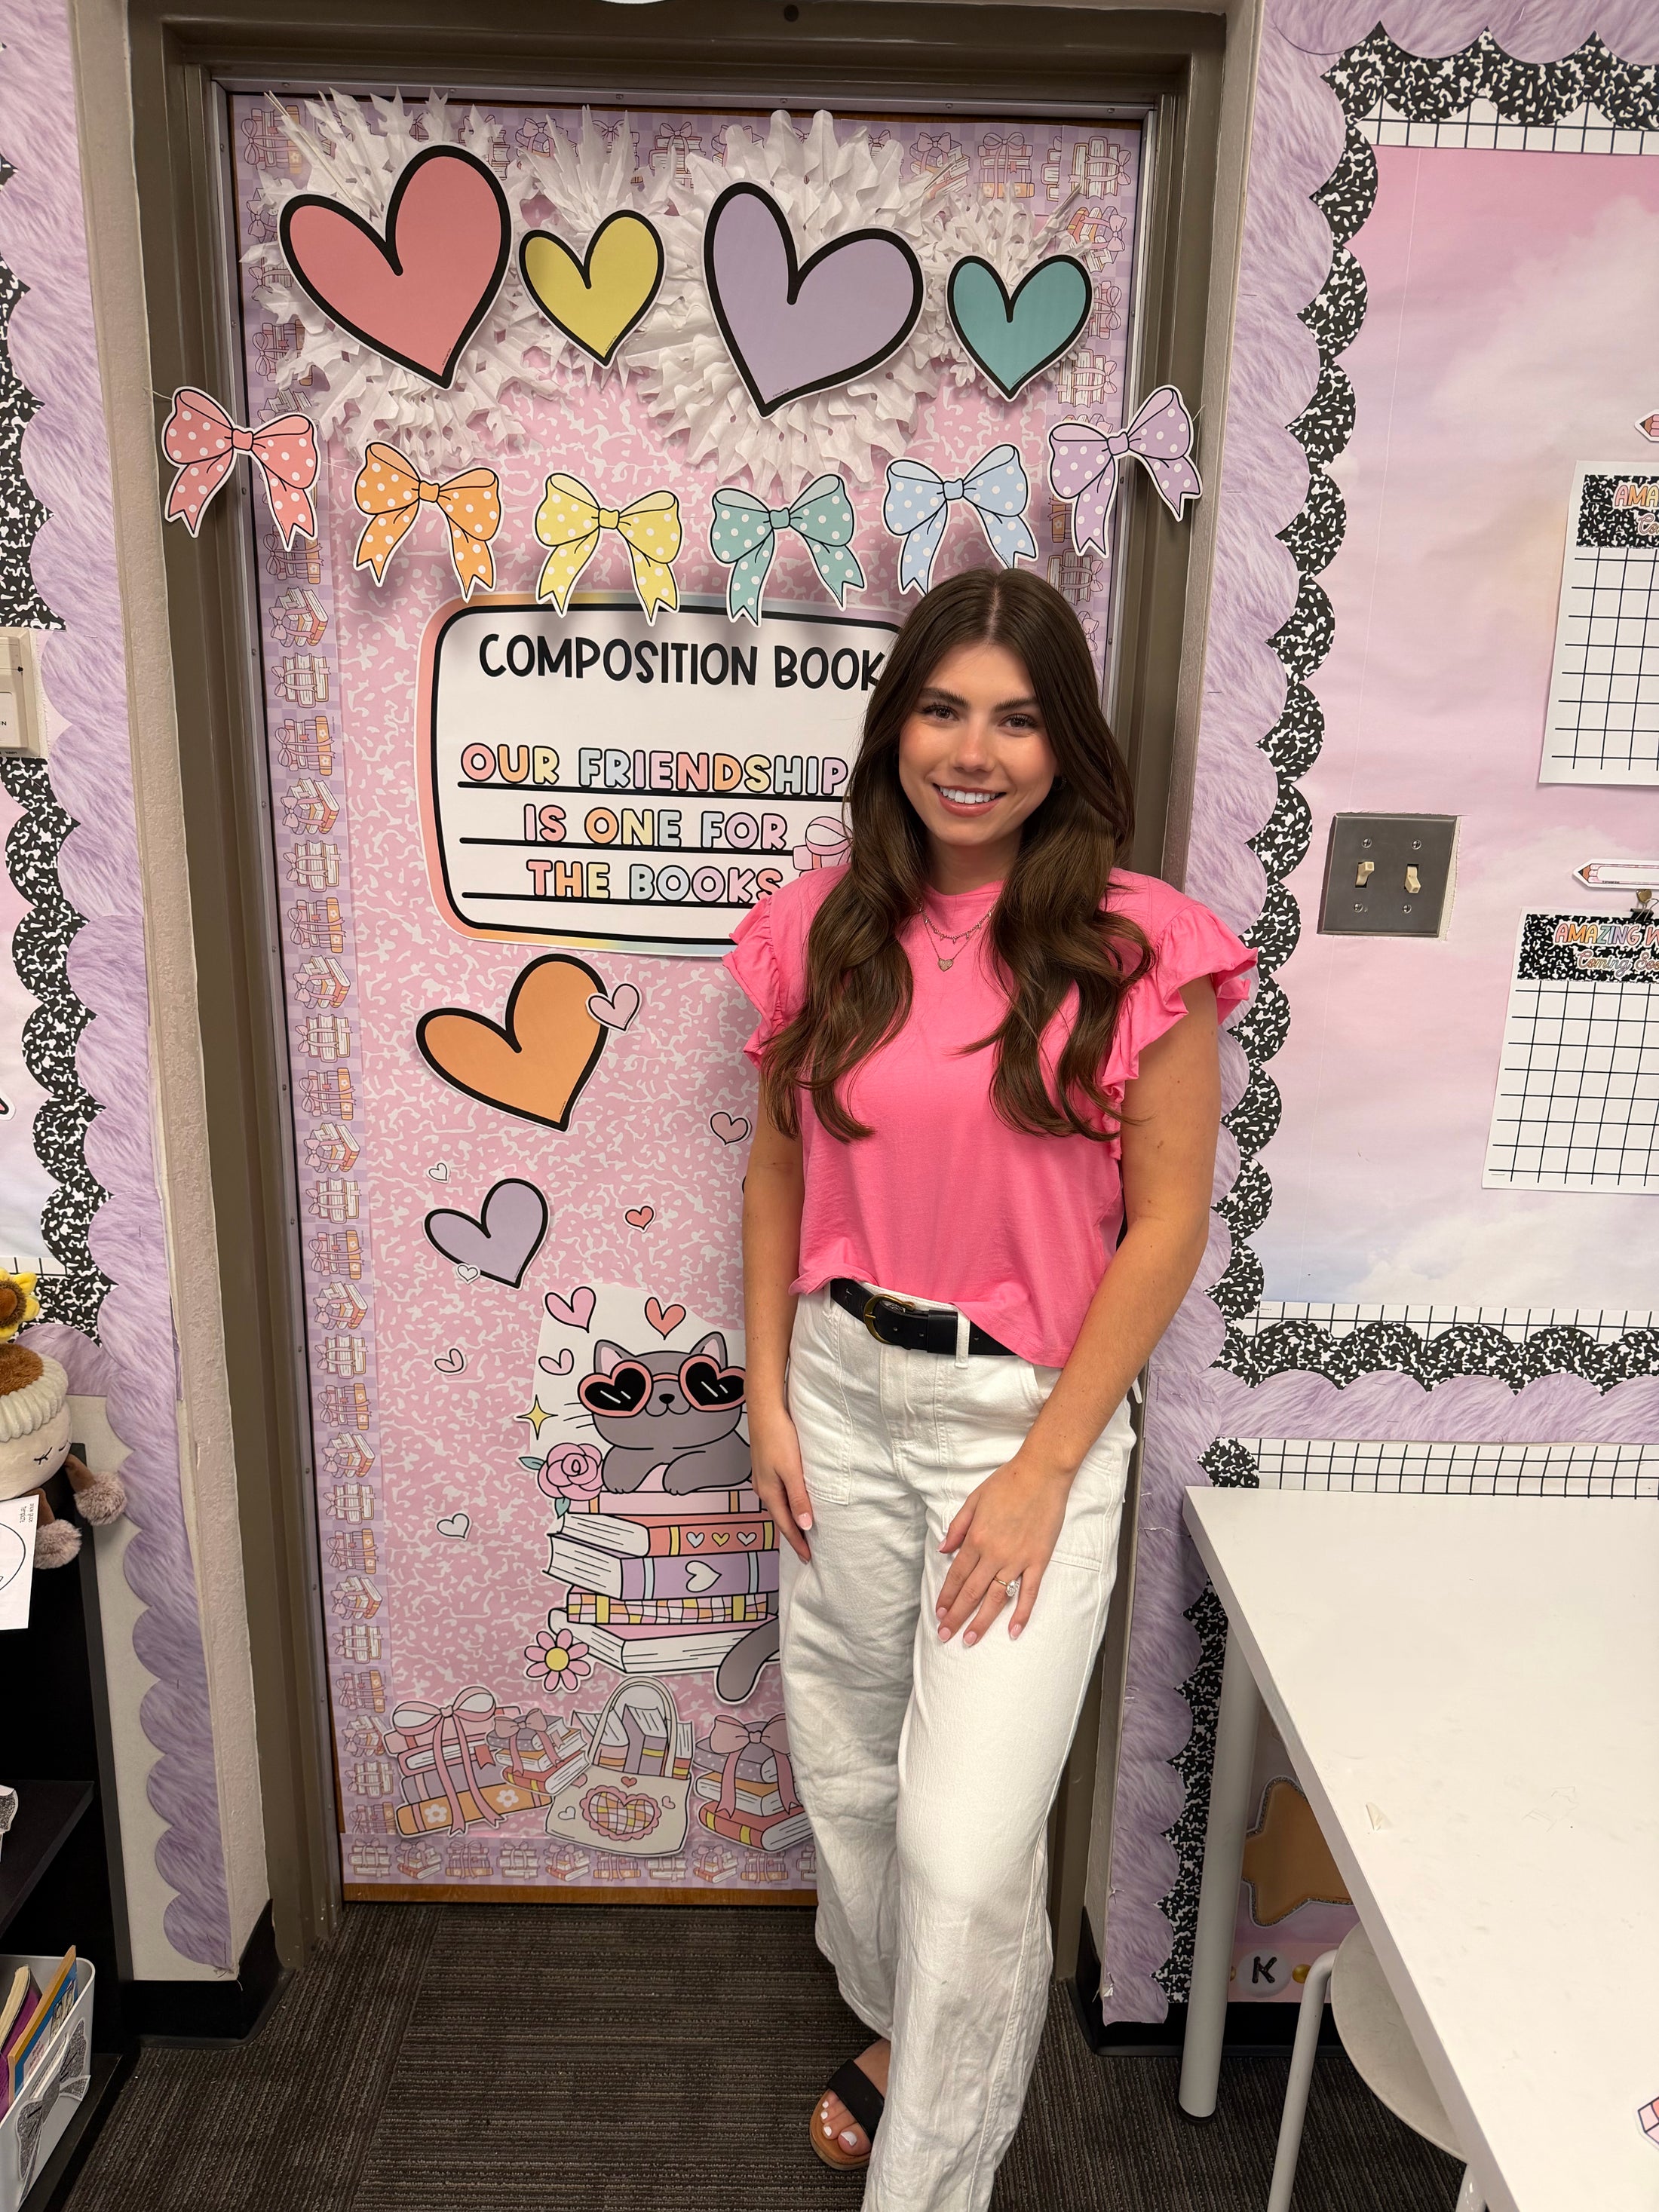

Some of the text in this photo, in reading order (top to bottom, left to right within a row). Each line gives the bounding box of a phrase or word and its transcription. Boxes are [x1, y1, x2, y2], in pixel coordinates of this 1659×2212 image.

[1615, 485, 1659, 507] AMA
[479, 633, 885, 691] COMPOSITION BOOK
[461, 743, 848, 795] OUR FRIENDSHIP
[523, 804, 788, 851] IS ONE FOR
[526, 859, 784, 903] THE BOOKS
[1554, 923, 1641, 946] AMAZING
[1577, 950, 1631, 978] Coming
[1252, 1956, 1278, 1984] K
